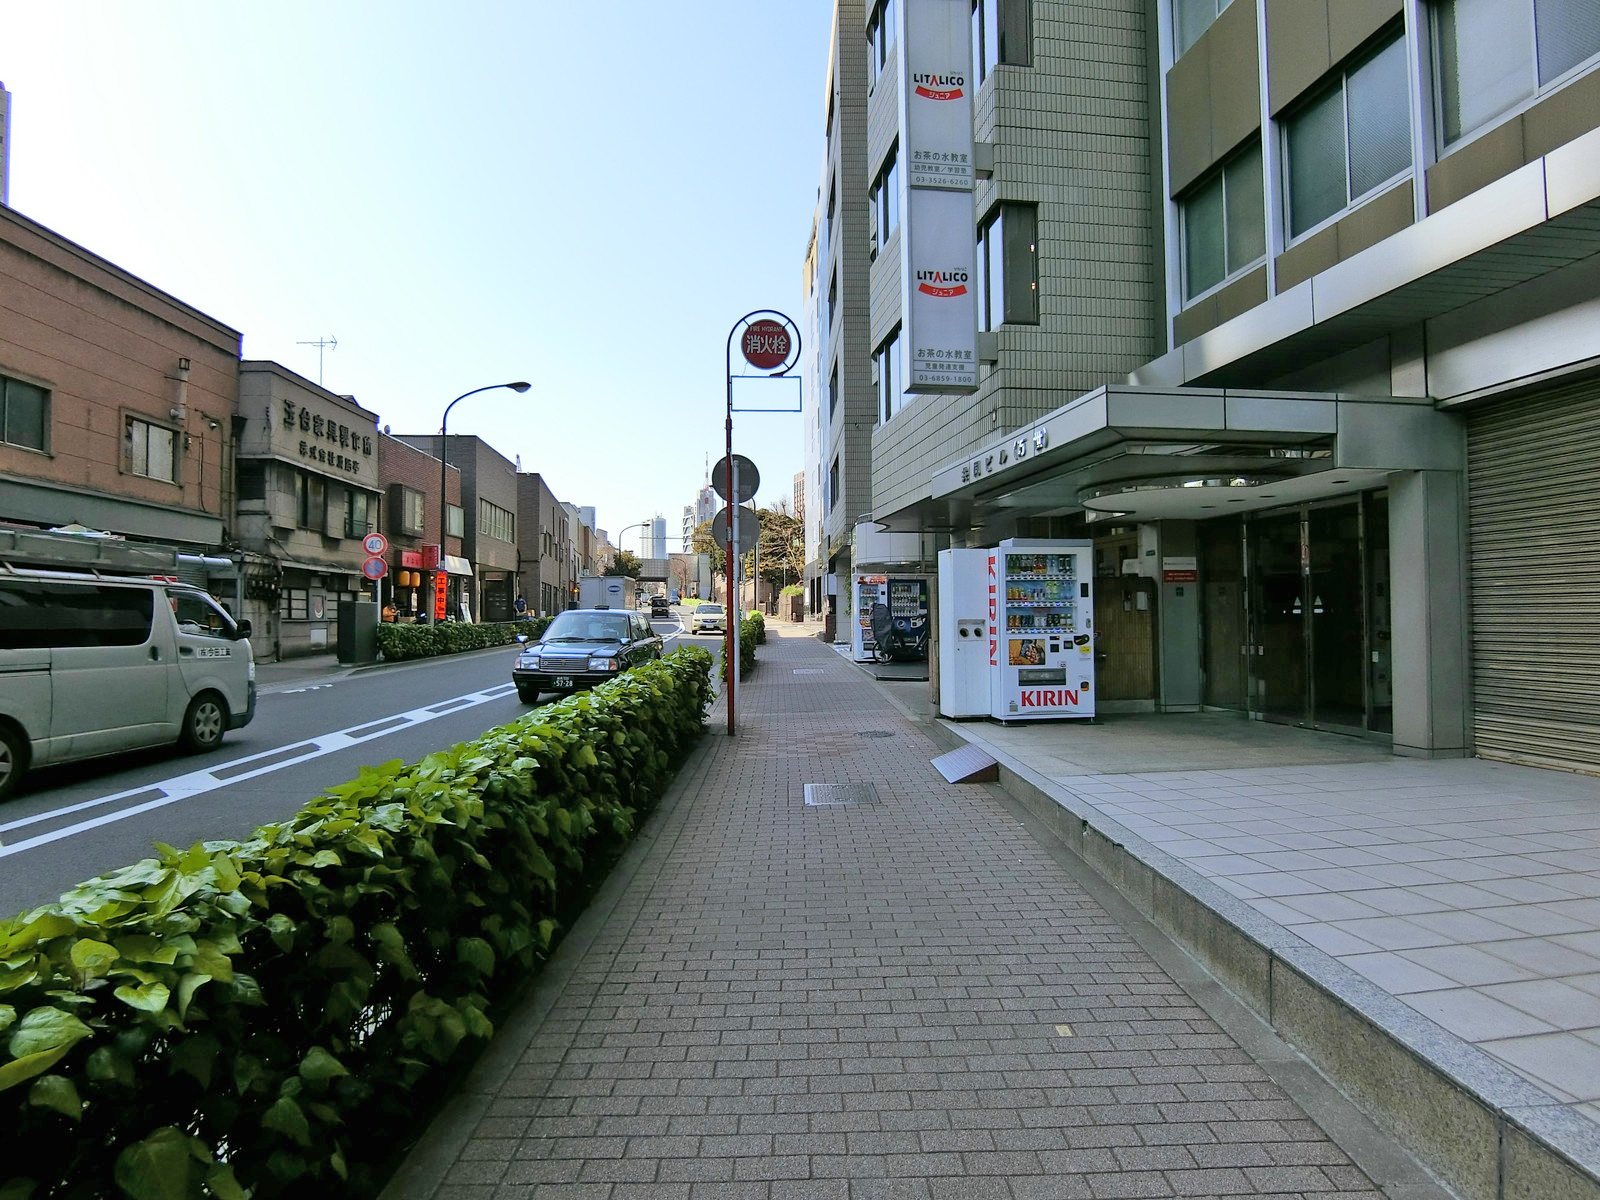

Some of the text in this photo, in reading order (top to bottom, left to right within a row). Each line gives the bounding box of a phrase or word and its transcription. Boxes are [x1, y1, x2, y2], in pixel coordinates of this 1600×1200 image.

[914, 73, 964, 86] LITALICO
[928, 91, 951, 99] ジュニア
[914, 151, 968, 163] お茶の水教室
[917, 270, 968, 283] LITALICO
[932, 288, 954, 296] ジュニア
[746, 335, 787, 354] 消火栓
[917, 348, 972, 360] お茶の水教室
[368, 540, 382, 549] 40
[1021, 690, 1078, 707] KIRIN
